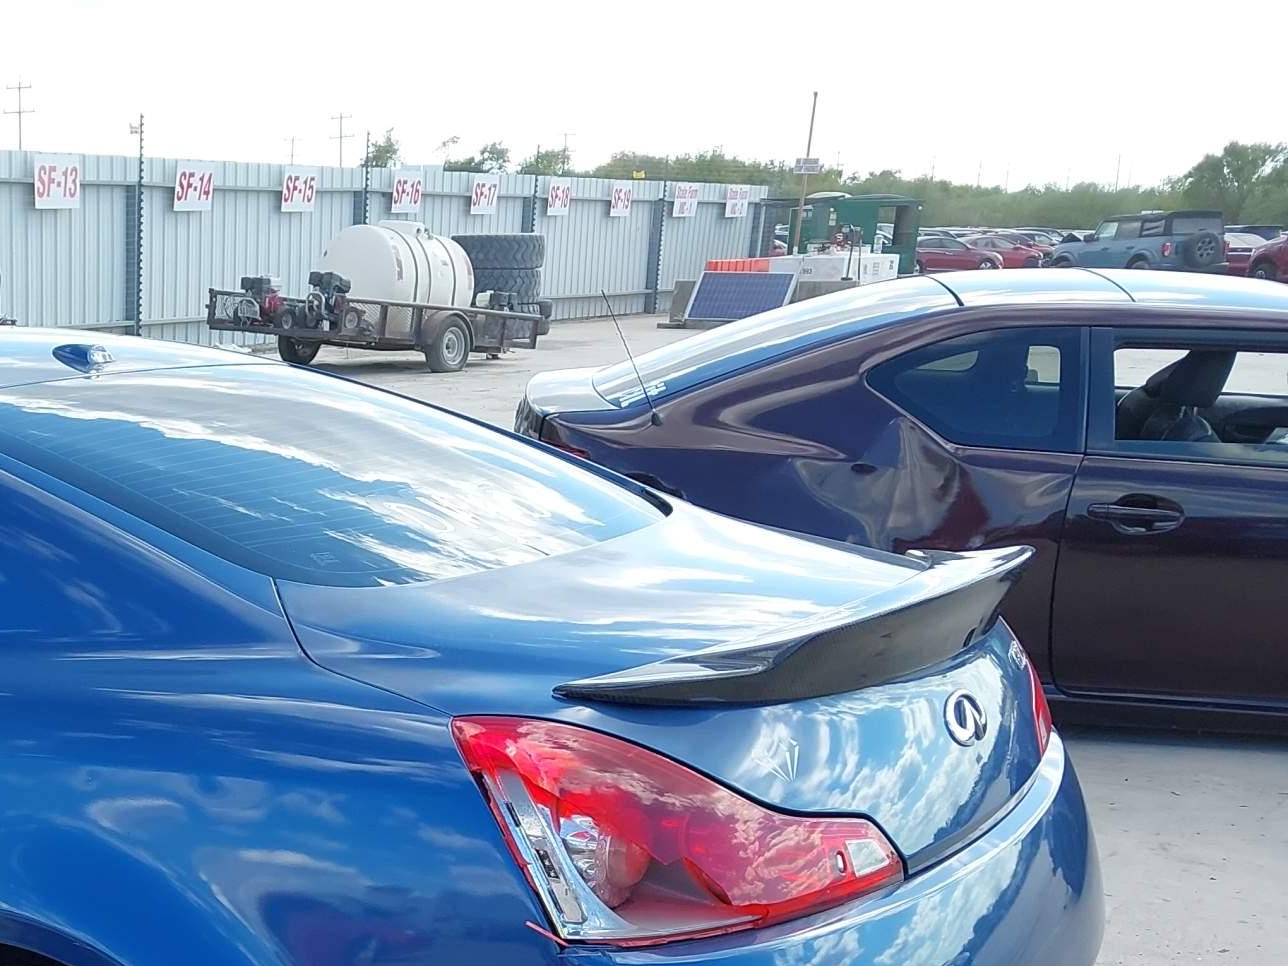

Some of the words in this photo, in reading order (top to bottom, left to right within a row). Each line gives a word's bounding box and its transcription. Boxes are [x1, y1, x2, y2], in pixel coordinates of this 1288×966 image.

[36, 164, 78, 199] SF-13
[176, 170, 213, 201] SF-14
[283, 174, 316, 203] SF-15
[393, 178, 422, 205] SF-16
[472, 182, 498, 207] SF-17
[548, 185, 570, 209] SF-18
